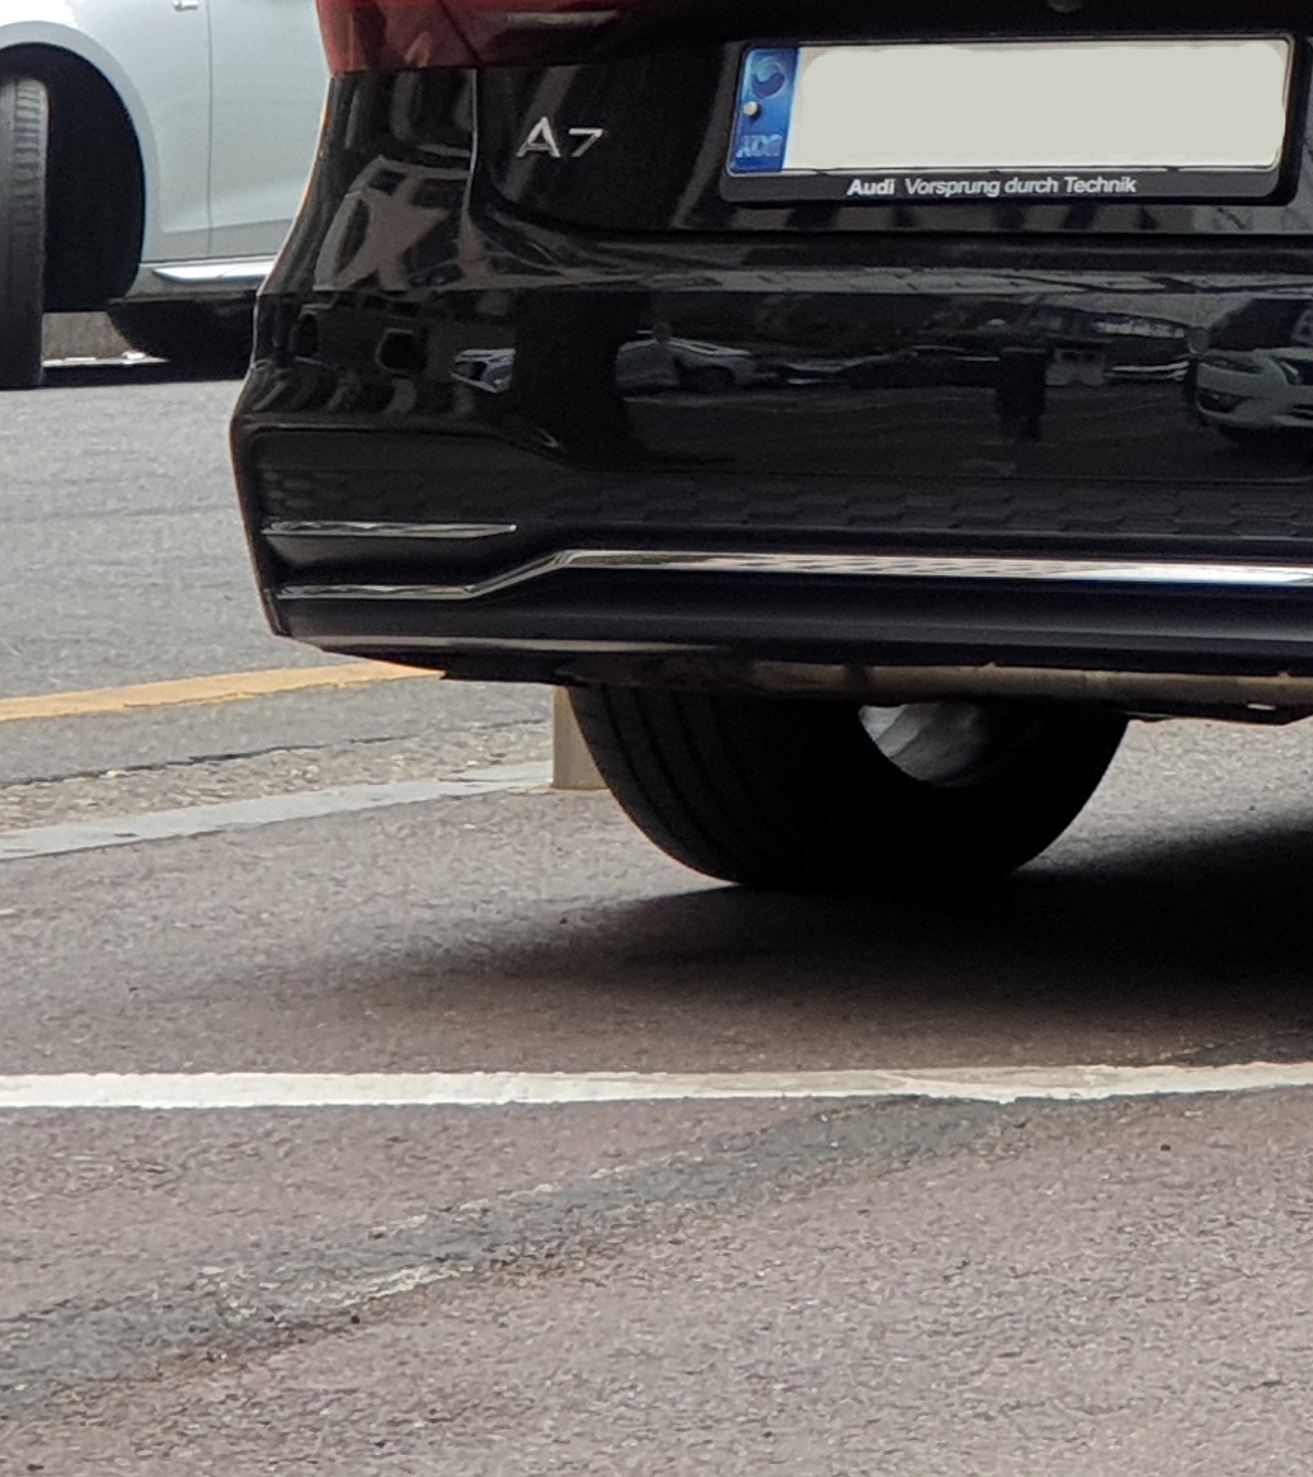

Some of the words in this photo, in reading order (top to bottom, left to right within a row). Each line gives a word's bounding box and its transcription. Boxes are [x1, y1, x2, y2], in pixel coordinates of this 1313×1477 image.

[517, 116, 604, 158] A7
[847, 178, 895, 195] Audi
[904, 178, 1000, 198] Vorsprung
[1005, 176, 1059, 193] durch
[1064, 175, 1137, 194] Technik
